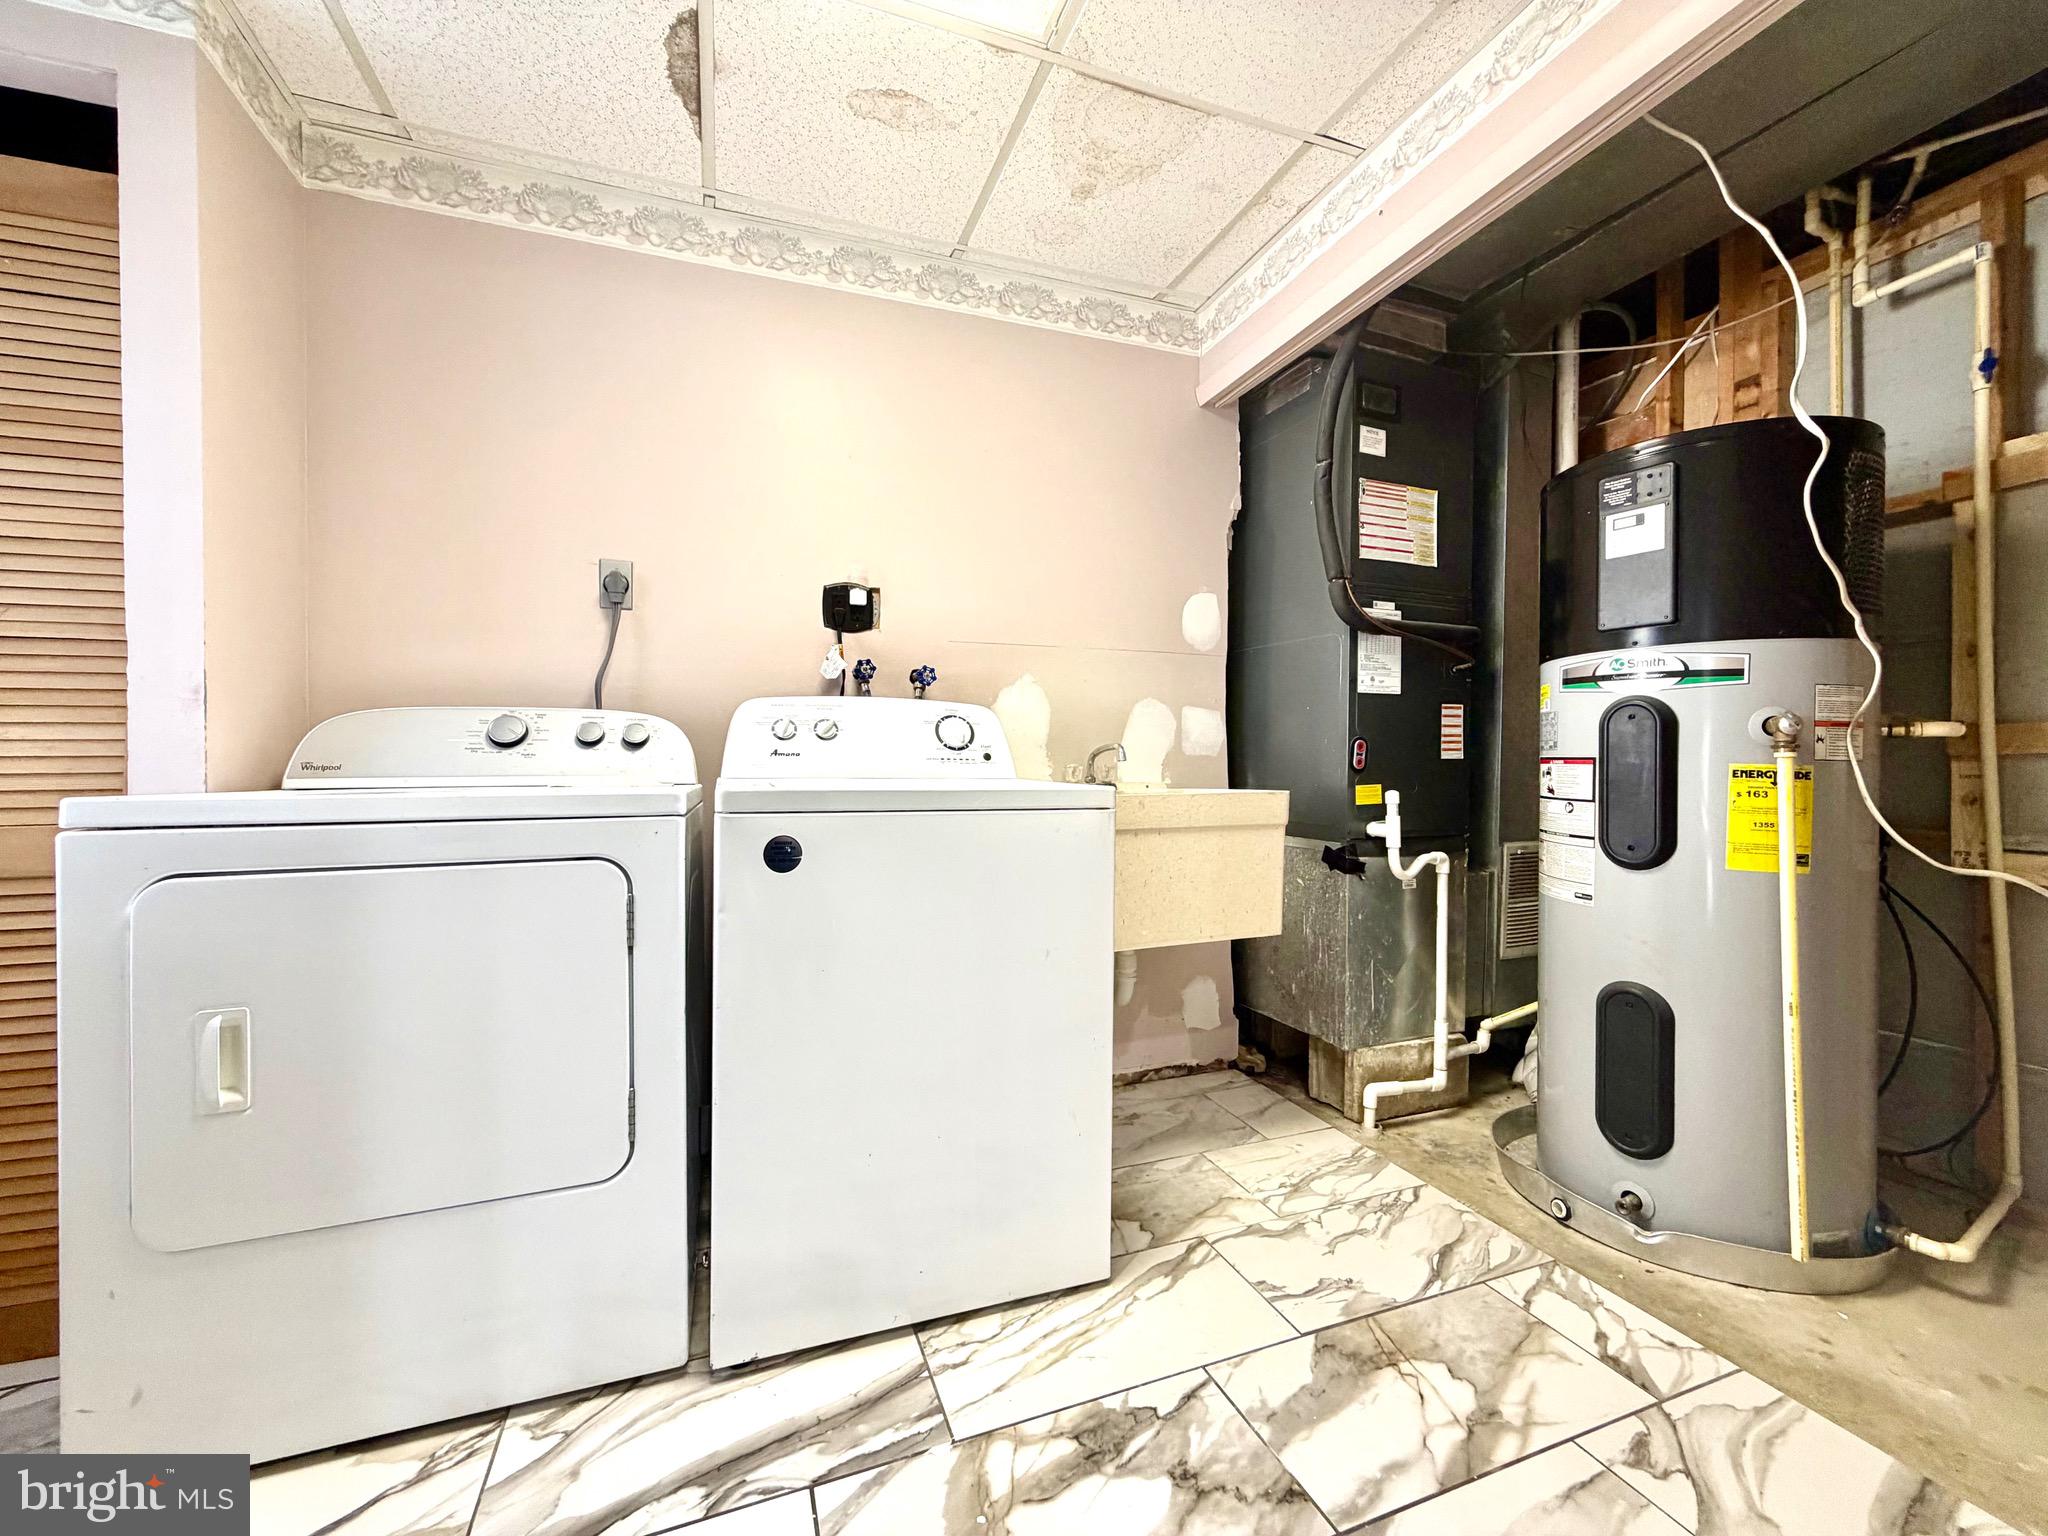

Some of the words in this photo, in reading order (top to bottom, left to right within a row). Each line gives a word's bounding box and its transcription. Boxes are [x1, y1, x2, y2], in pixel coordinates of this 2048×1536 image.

[1627, 657, 1666, 669] Smith
[770, 749, 801, 757] Amana
[300, 763, 342, 772] Whirlpool
[1746, 790, 1769, 798] 163
